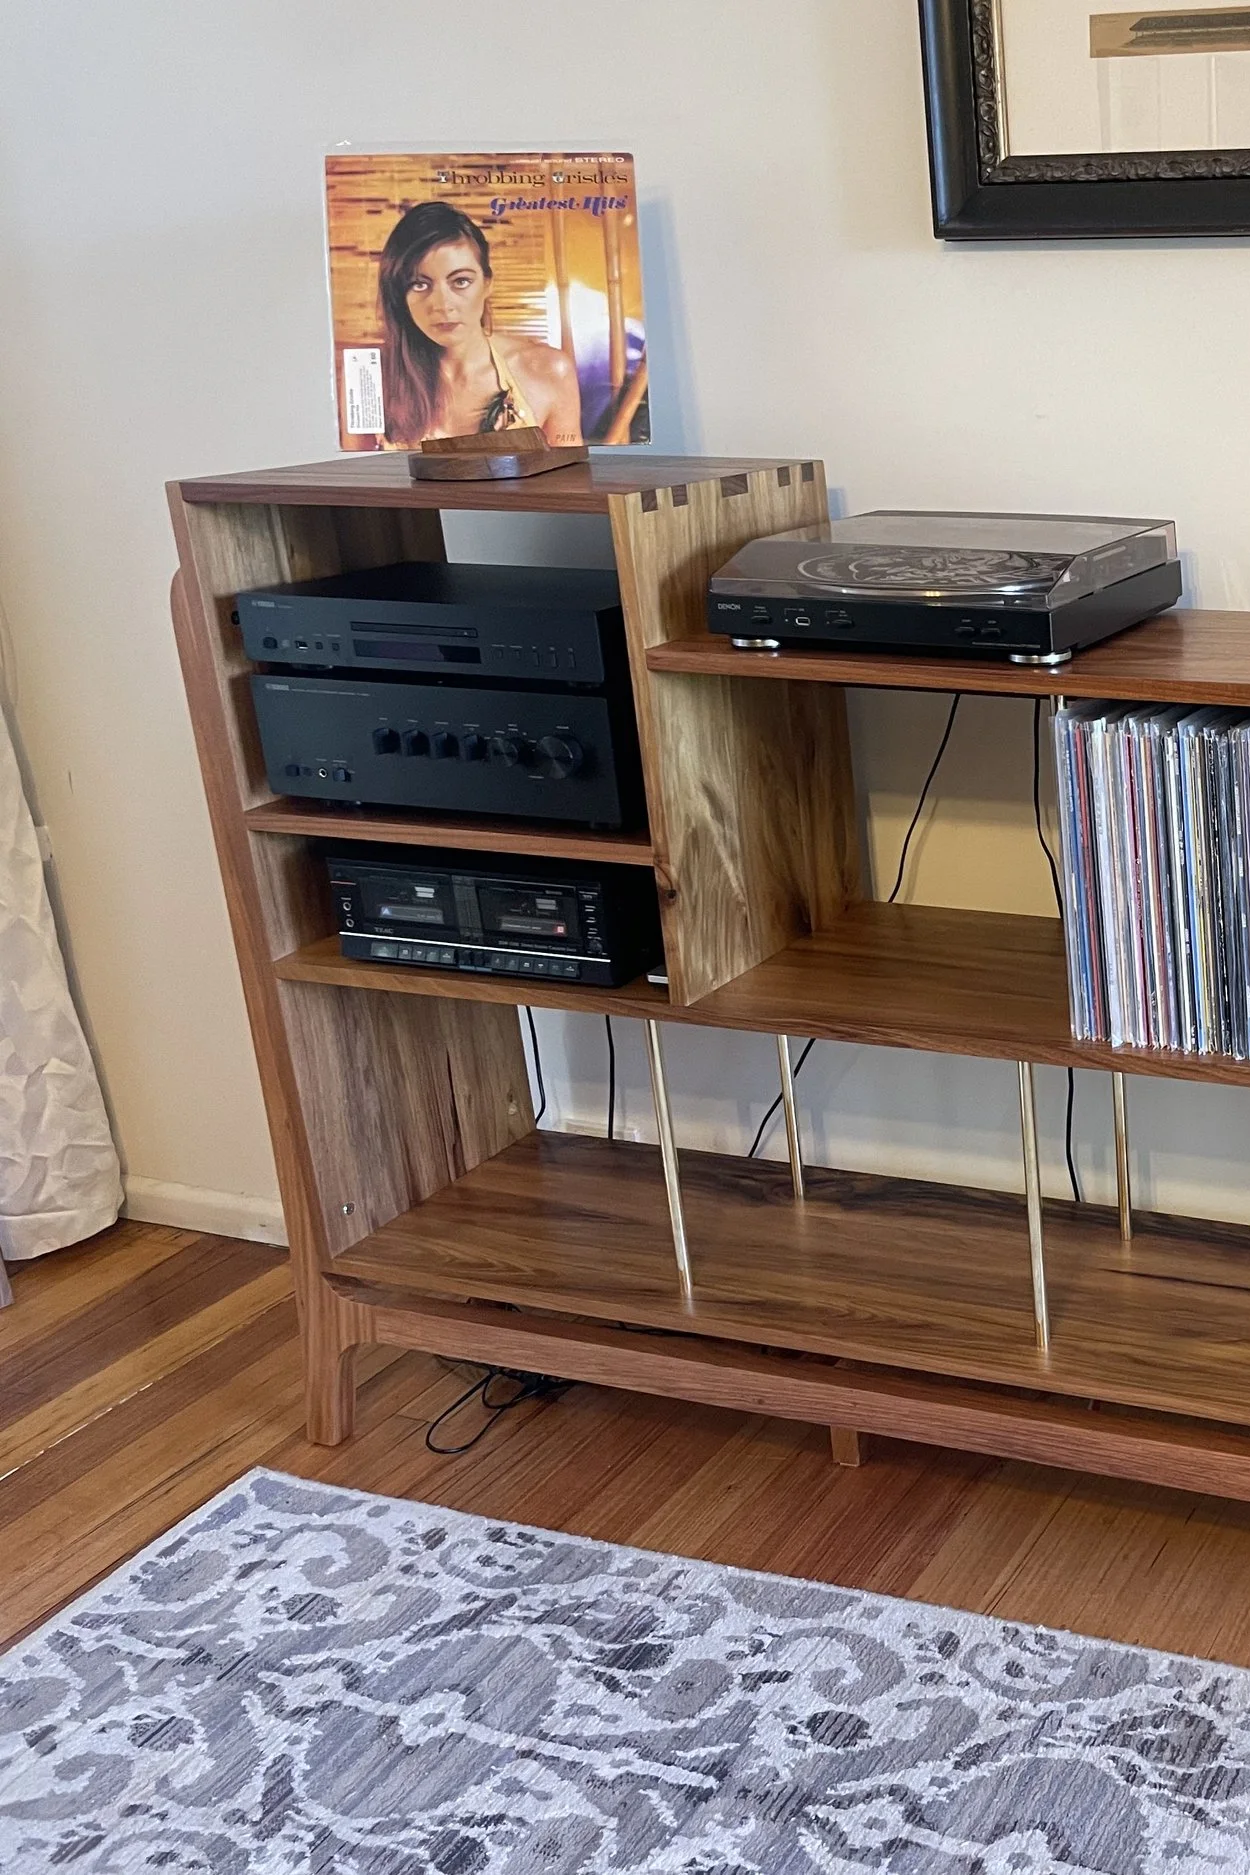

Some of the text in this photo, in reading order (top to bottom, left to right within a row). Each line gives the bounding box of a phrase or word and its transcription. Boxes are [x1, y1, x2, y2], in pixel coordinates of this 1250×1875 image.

[437, 170, 545, 187] Throbbing
[489, 197, 580, 216] Greatest
[556, 434, 577, 442] PAIN
